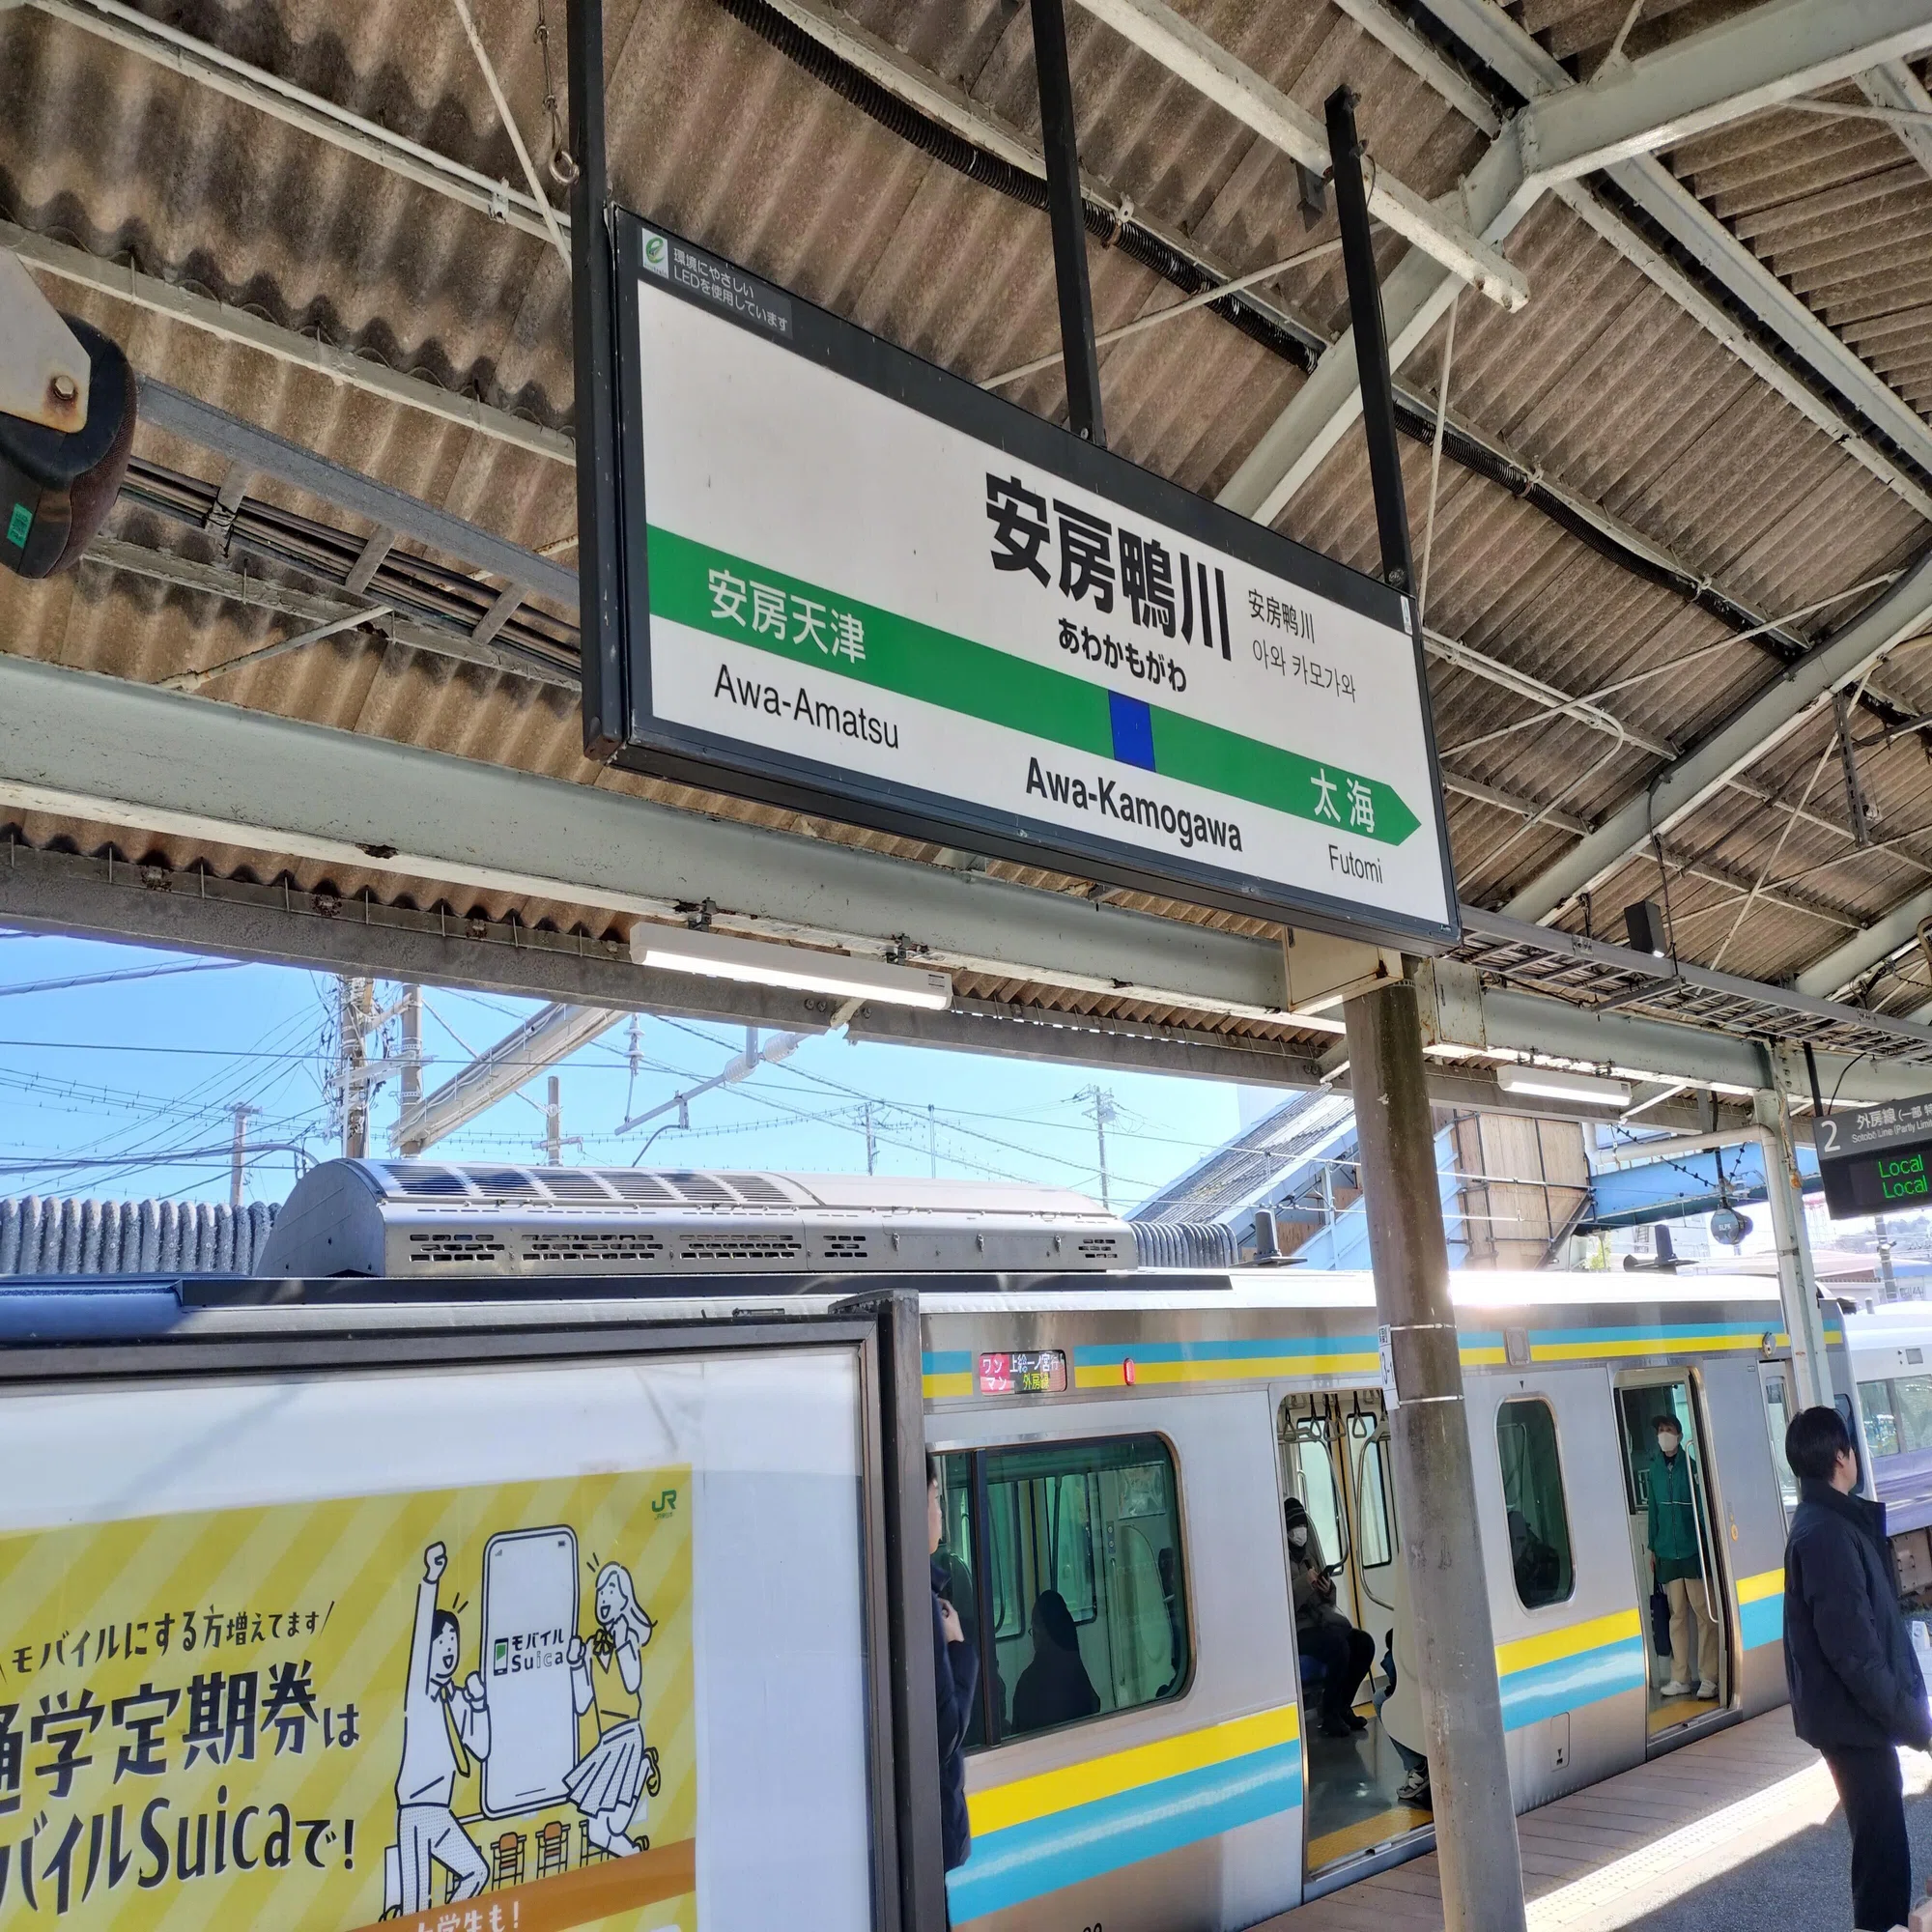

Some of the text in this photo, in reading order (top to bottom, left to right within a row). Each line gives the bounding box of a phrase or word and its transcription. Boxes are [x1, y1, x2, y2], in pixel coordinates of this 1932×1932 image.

[673, 247, 754, 299] 環境にやさしい
[673, 265, 788, 331] LEDを使用しています
[985, 471, 1232, 662] 安房鴨川
[707, 568, 867, 664] 安房天津
[1248, 588, 1316, 643] 安房鸭川
[1058, 618, 1187, 693] あわかもがわ
[1252, 639, 1356, 703] 아와 카모가와
[714, 663, 899, 750] Awa-Amatsu
[1025, 756, 1243, 852] Awa-Kamogawa
[1310, 768, 1376, 835] 太海
[1328, 844, 1383, 884] Futomi
[1821, 1120, 1841, 1152] 2
[1878, 1154, 1924, 1178] Local
[1883, 1175, 1928, 1198] Local
[982, 1358, 1003, 1374] ワン
[986, 1377, 1007, 1390] マン
[1023, 1373, 1050, 1391] 外房線
[652, 1489, 677, 1513] JR
[12, 1604, 320, 1674] モバイルにする方増えてます
[511, 1650, 564, 1673] Suica
[512, 1628, 564, 1651] モバイル
